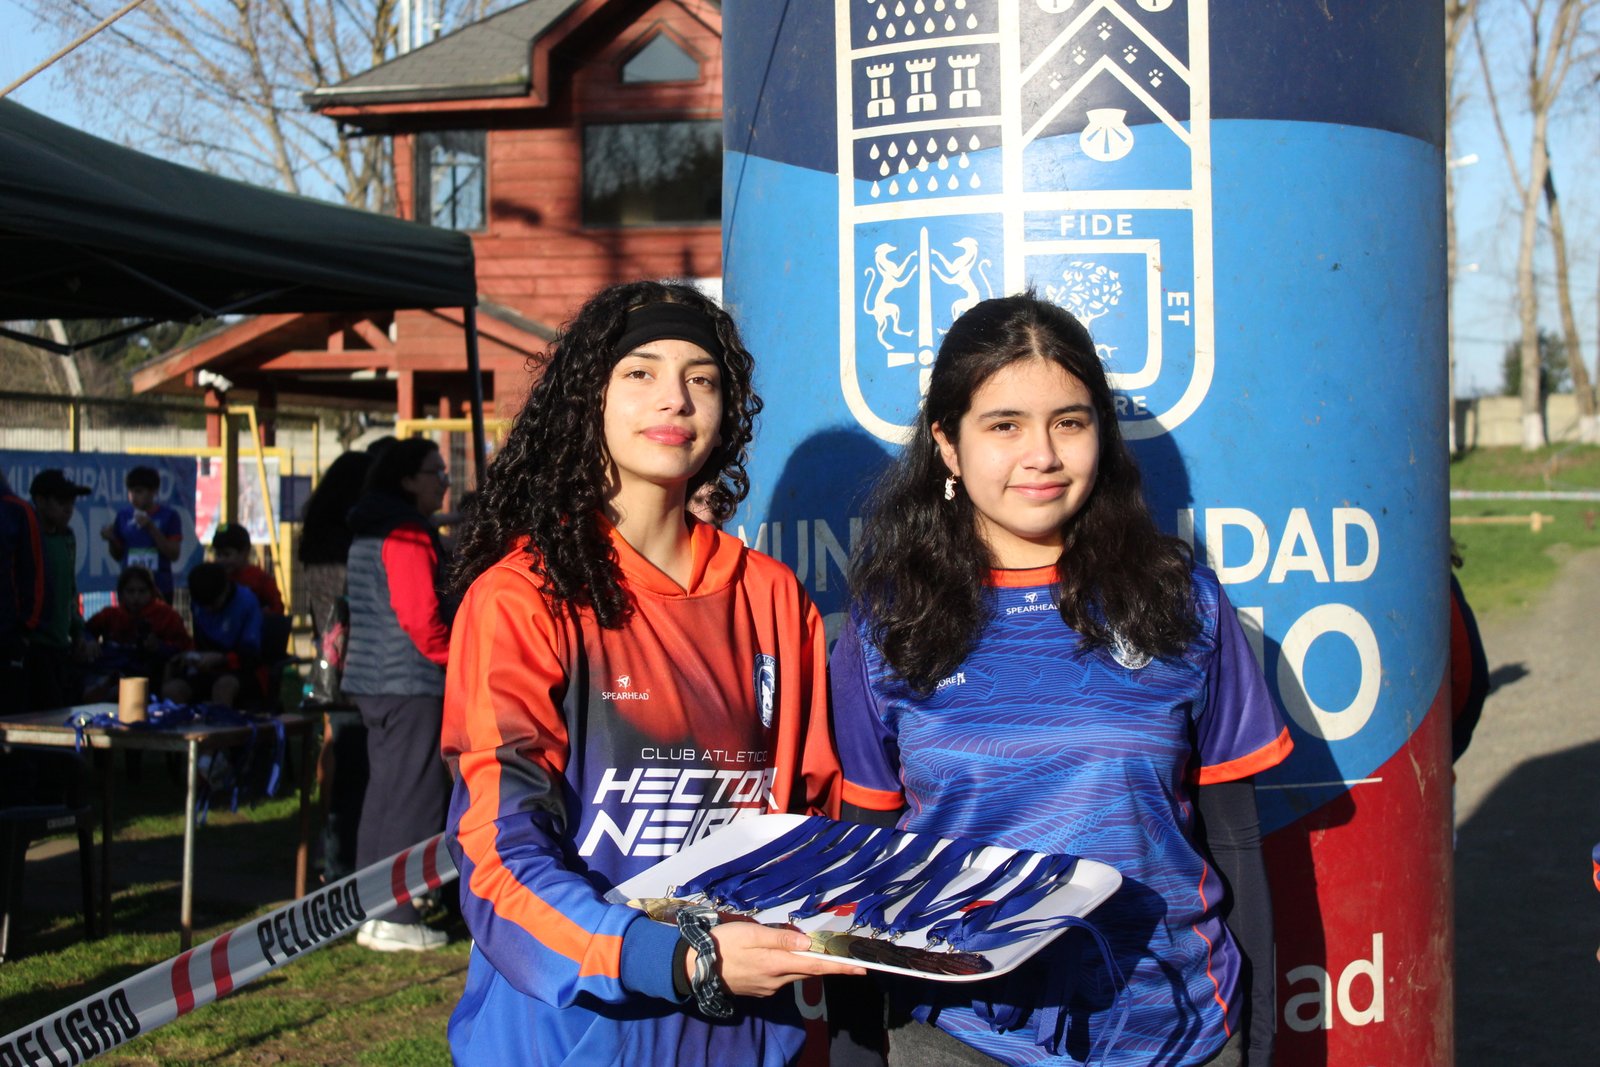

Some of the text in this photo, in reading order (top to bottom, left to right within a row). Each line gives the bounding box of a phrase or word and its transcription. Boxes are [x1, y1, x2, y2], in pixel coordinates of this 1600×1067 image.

[1060, 214, 1133, 236] FIDE
[1167, 292, 1189, 326] ET
[601, 691, 650, 701] SPEARHEAD
[641, 747, 696, 761] CLUB
[592, 767, 779, 810] HECTOR
[257, 877, 367, 966] PELIGRO
